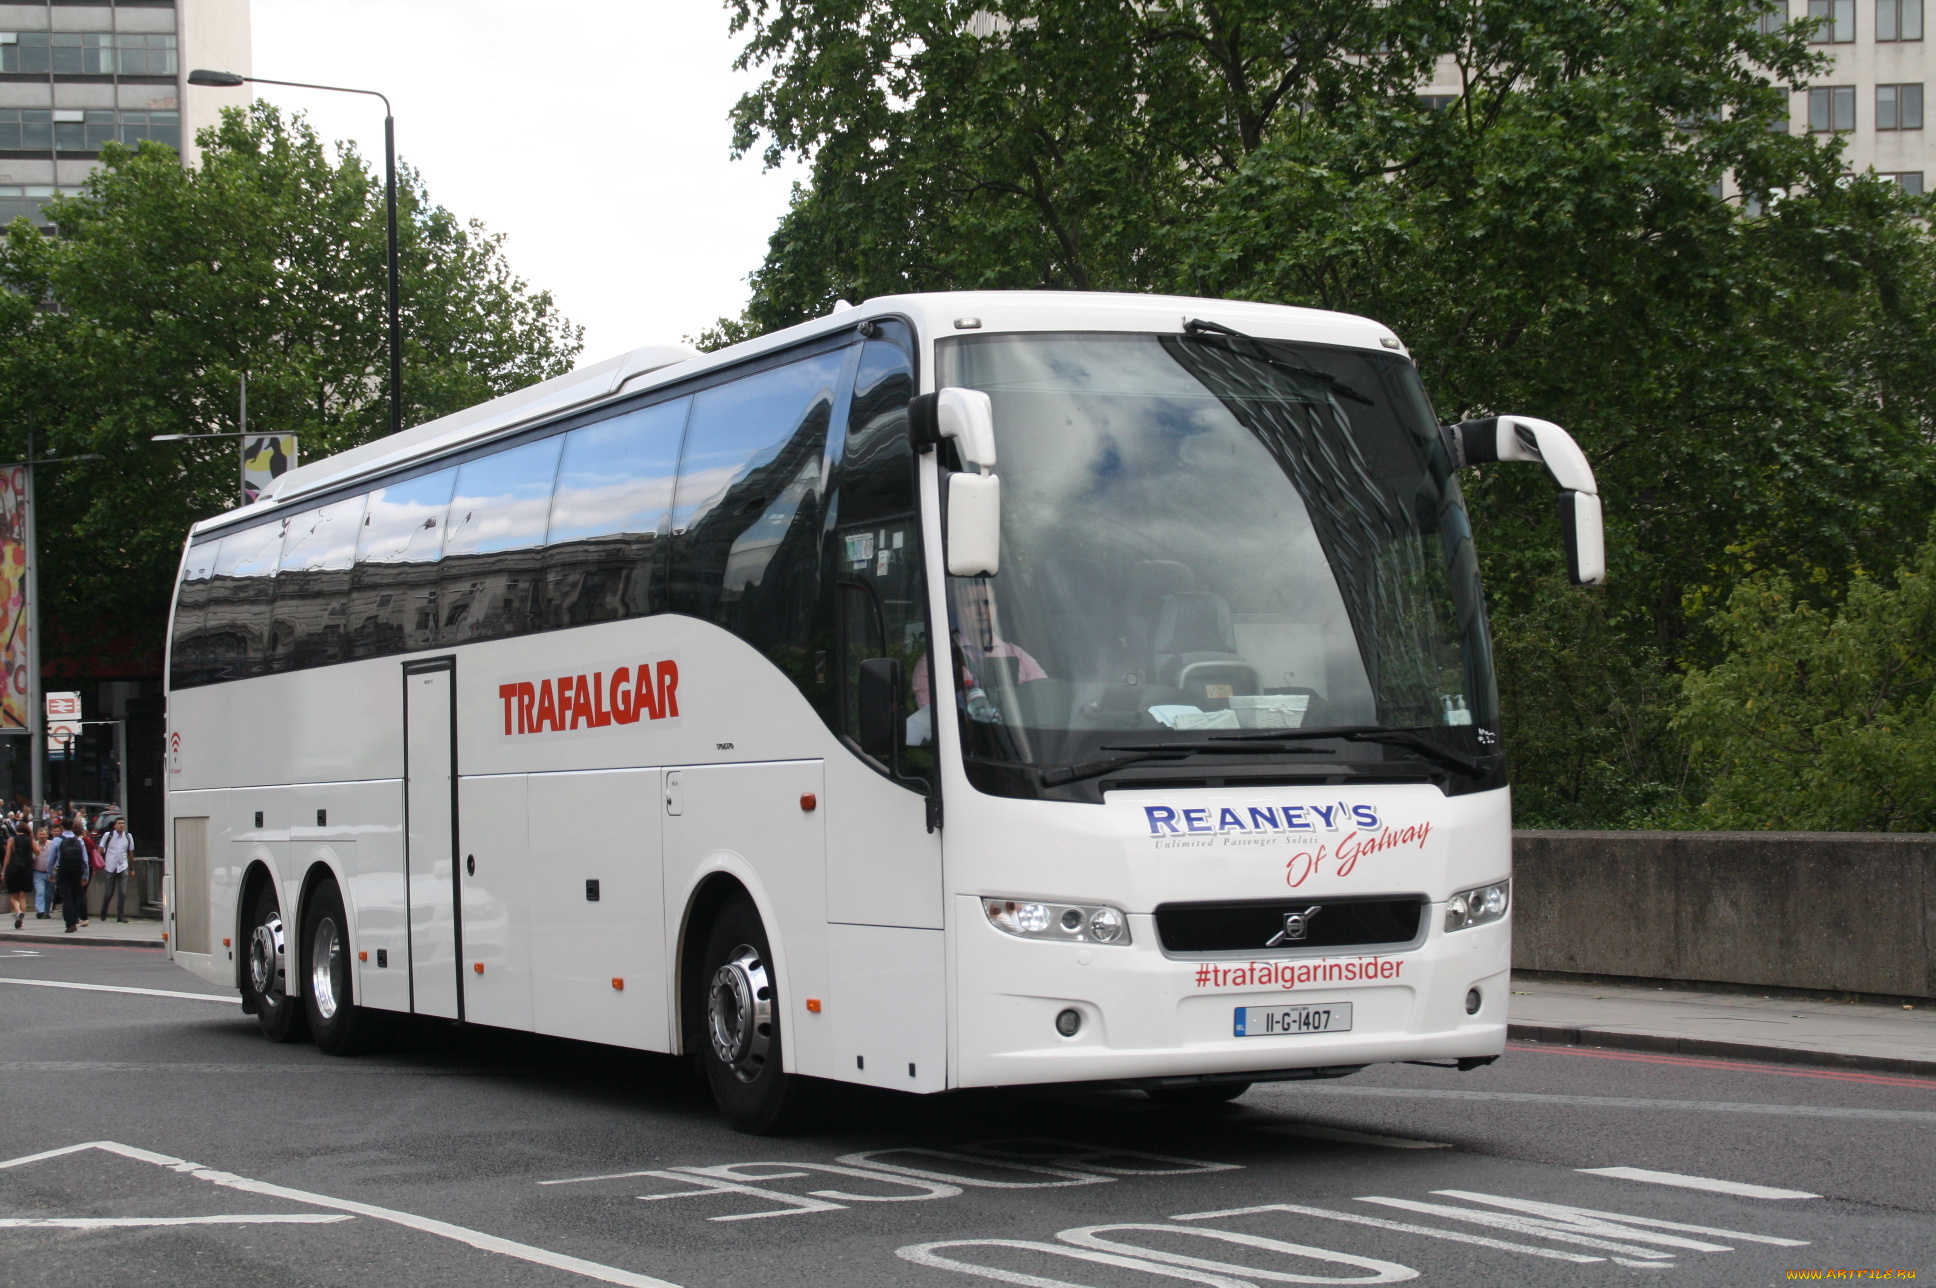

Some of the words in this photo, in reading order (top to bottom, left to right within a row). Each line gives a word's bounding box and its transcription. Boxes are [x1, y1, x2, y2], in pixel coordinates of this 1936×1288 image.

[499, 659, 679, 735] TRAFALGAR
[1143, 801, 1381, 836] REANEY'S
[1155, 838, 1214, 849] Unlimited
[1223, 837, 1277, 847] Passenger
[1286, 844, 1327, 888] Of
[1335, 821, 1434, 877] Galway
[1196, 956, 1404, 989] #trafalgarinsider
[1266, 1010, 1331, 1032] 11-G-1407
